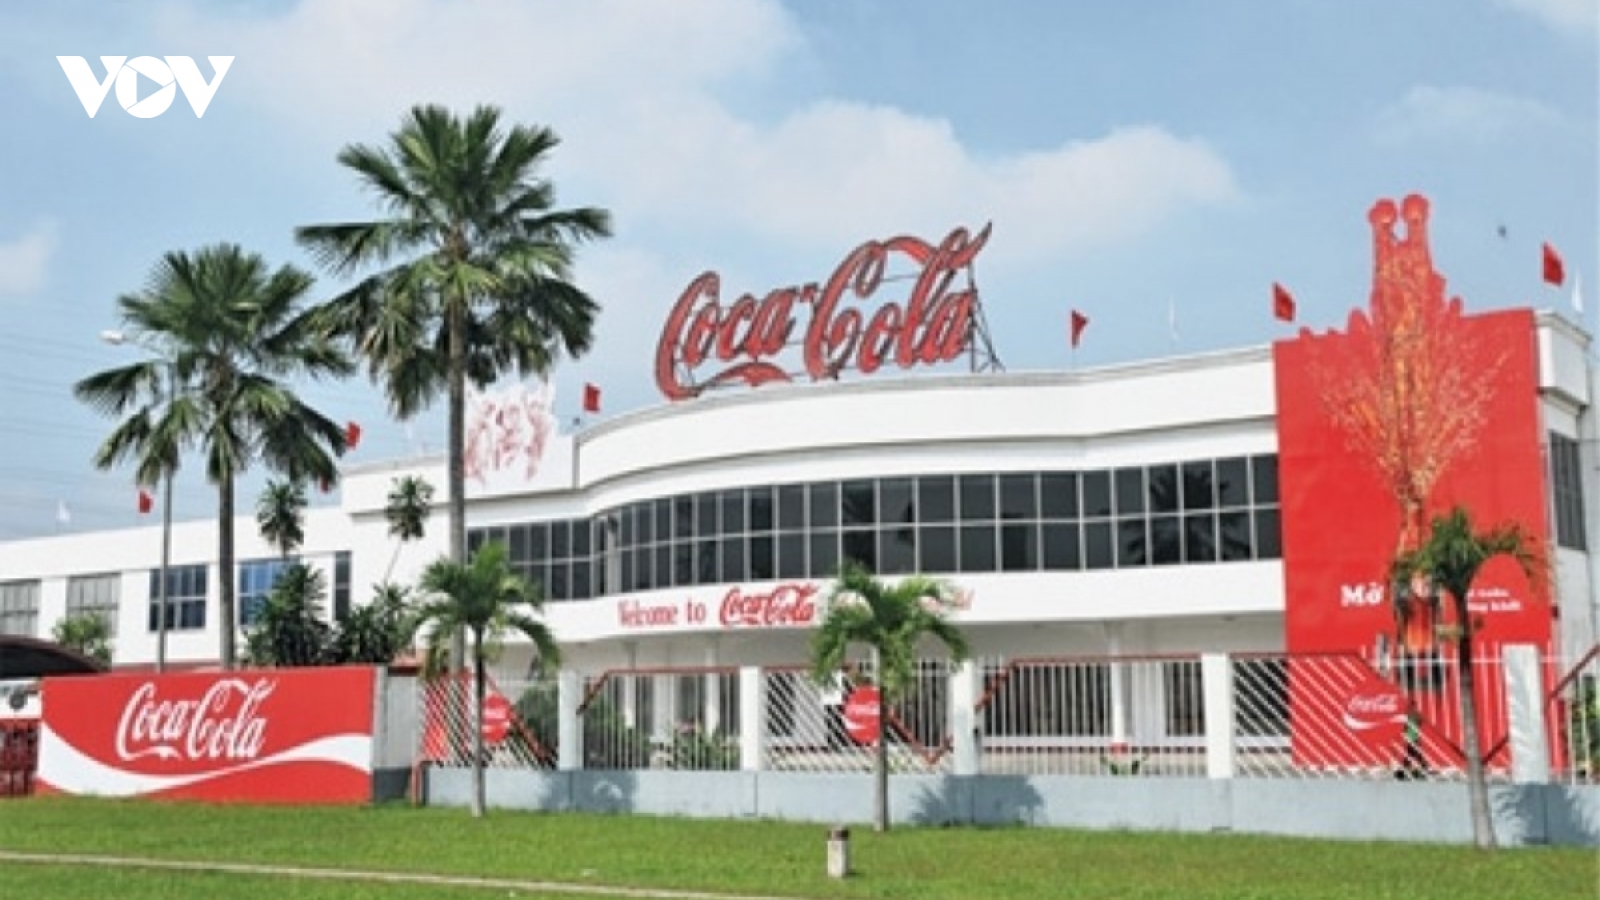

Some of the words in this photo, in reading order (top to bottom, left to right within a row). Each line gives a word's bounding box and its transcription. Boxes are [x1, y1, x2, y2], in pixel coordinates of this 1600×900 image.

[655, 219, 993, 402] Coca-Cola
[617, 598, 678, 627] Welcome
[686, 597, 708, 624] to
[718, 583, 818, 627] Coca-Cola
[115, 677, 278, 762] Coca-Cola
